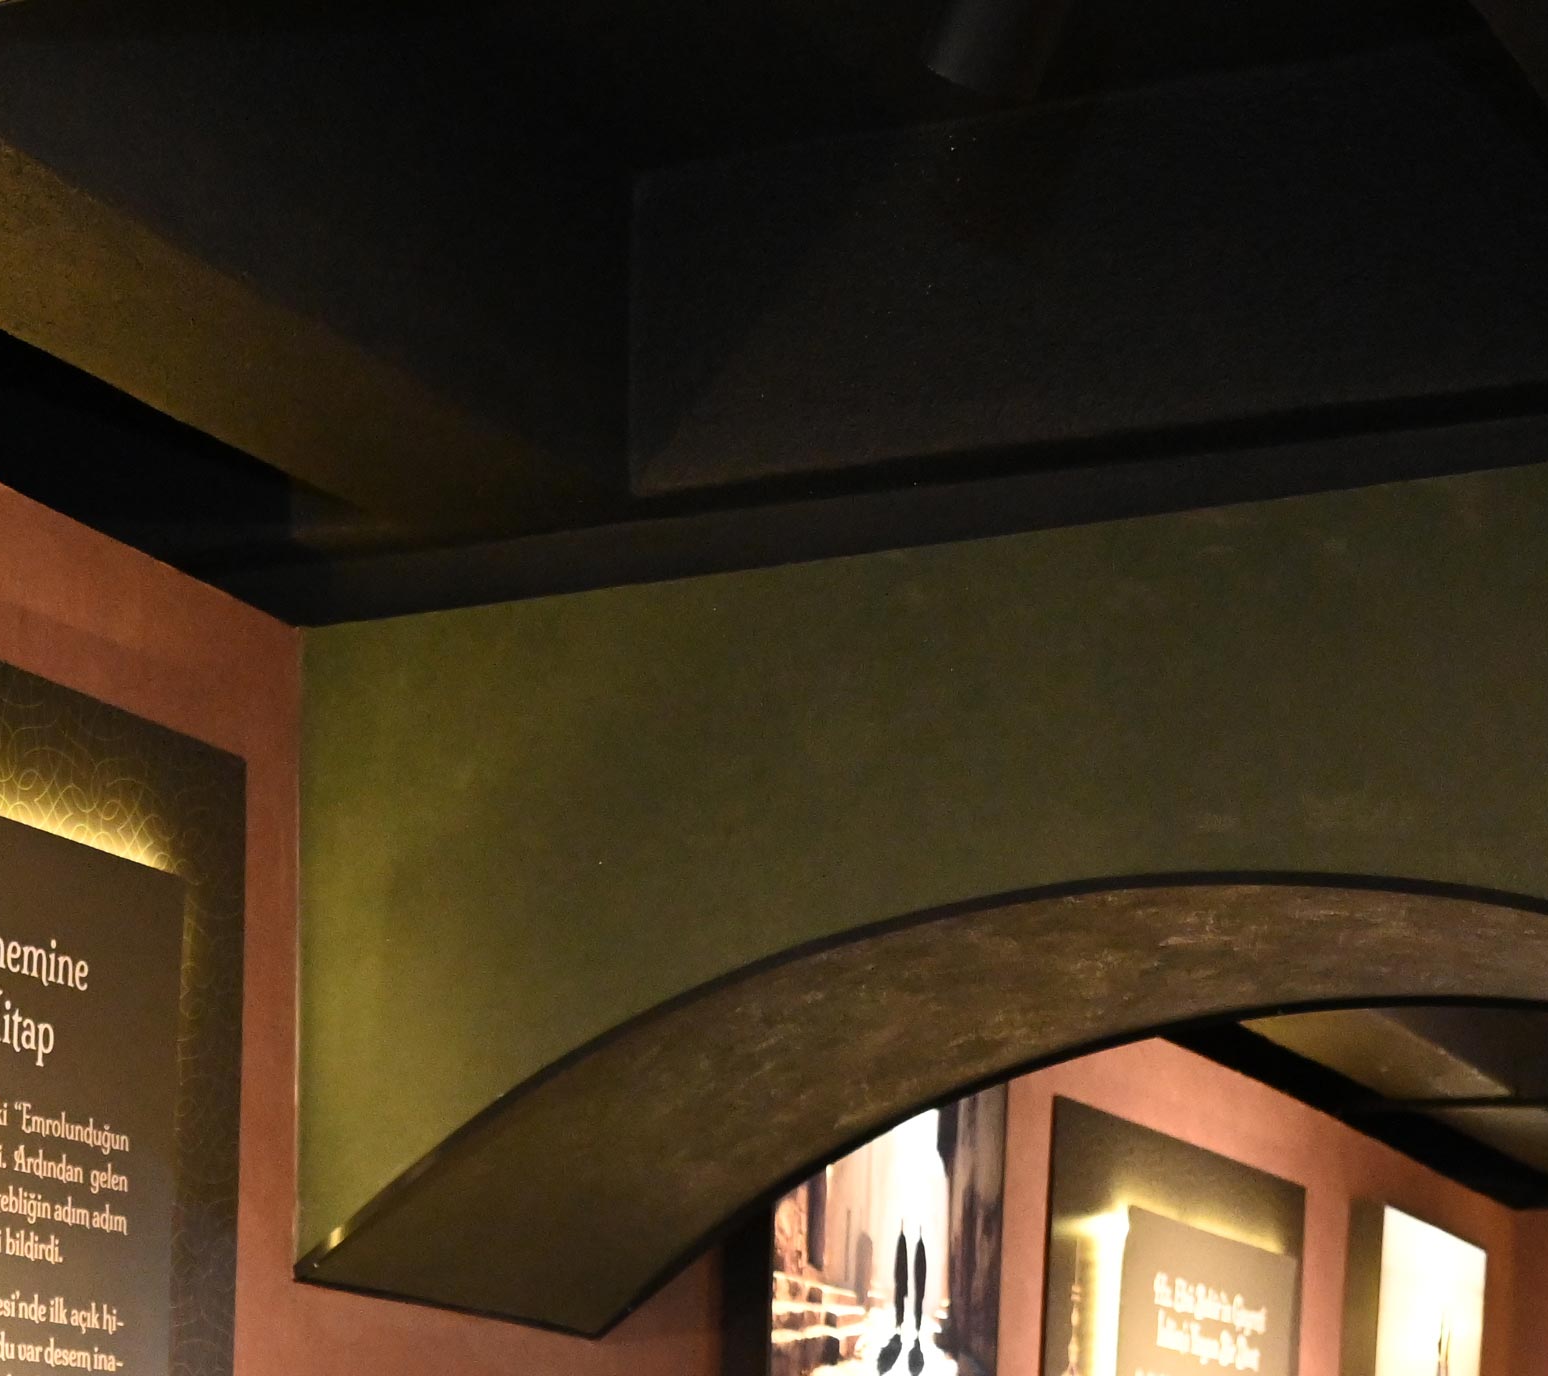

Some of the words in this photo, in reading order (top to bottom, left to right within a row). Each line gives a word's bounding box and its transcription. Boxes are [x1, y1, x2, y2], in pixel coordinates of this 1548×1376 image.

[14, 1145, 83, 1183] Ardından
[91, 1163, 128, 1193] gelen
[54, 1197, 89, 1229] adım
[92, 1204, 127, 1235] adım
[6, 1228, 63, 1264] bildirdi.
[50, 1297, 67, 1324] ilk
[71, 1302, 99, 1334] açık
[103, 1304, 124, 1334] hi-
[18, 1344, 43, 1362] var
[44, 1338, 91, 1371] desem
[94, 1347, 123, 1371] ina-
